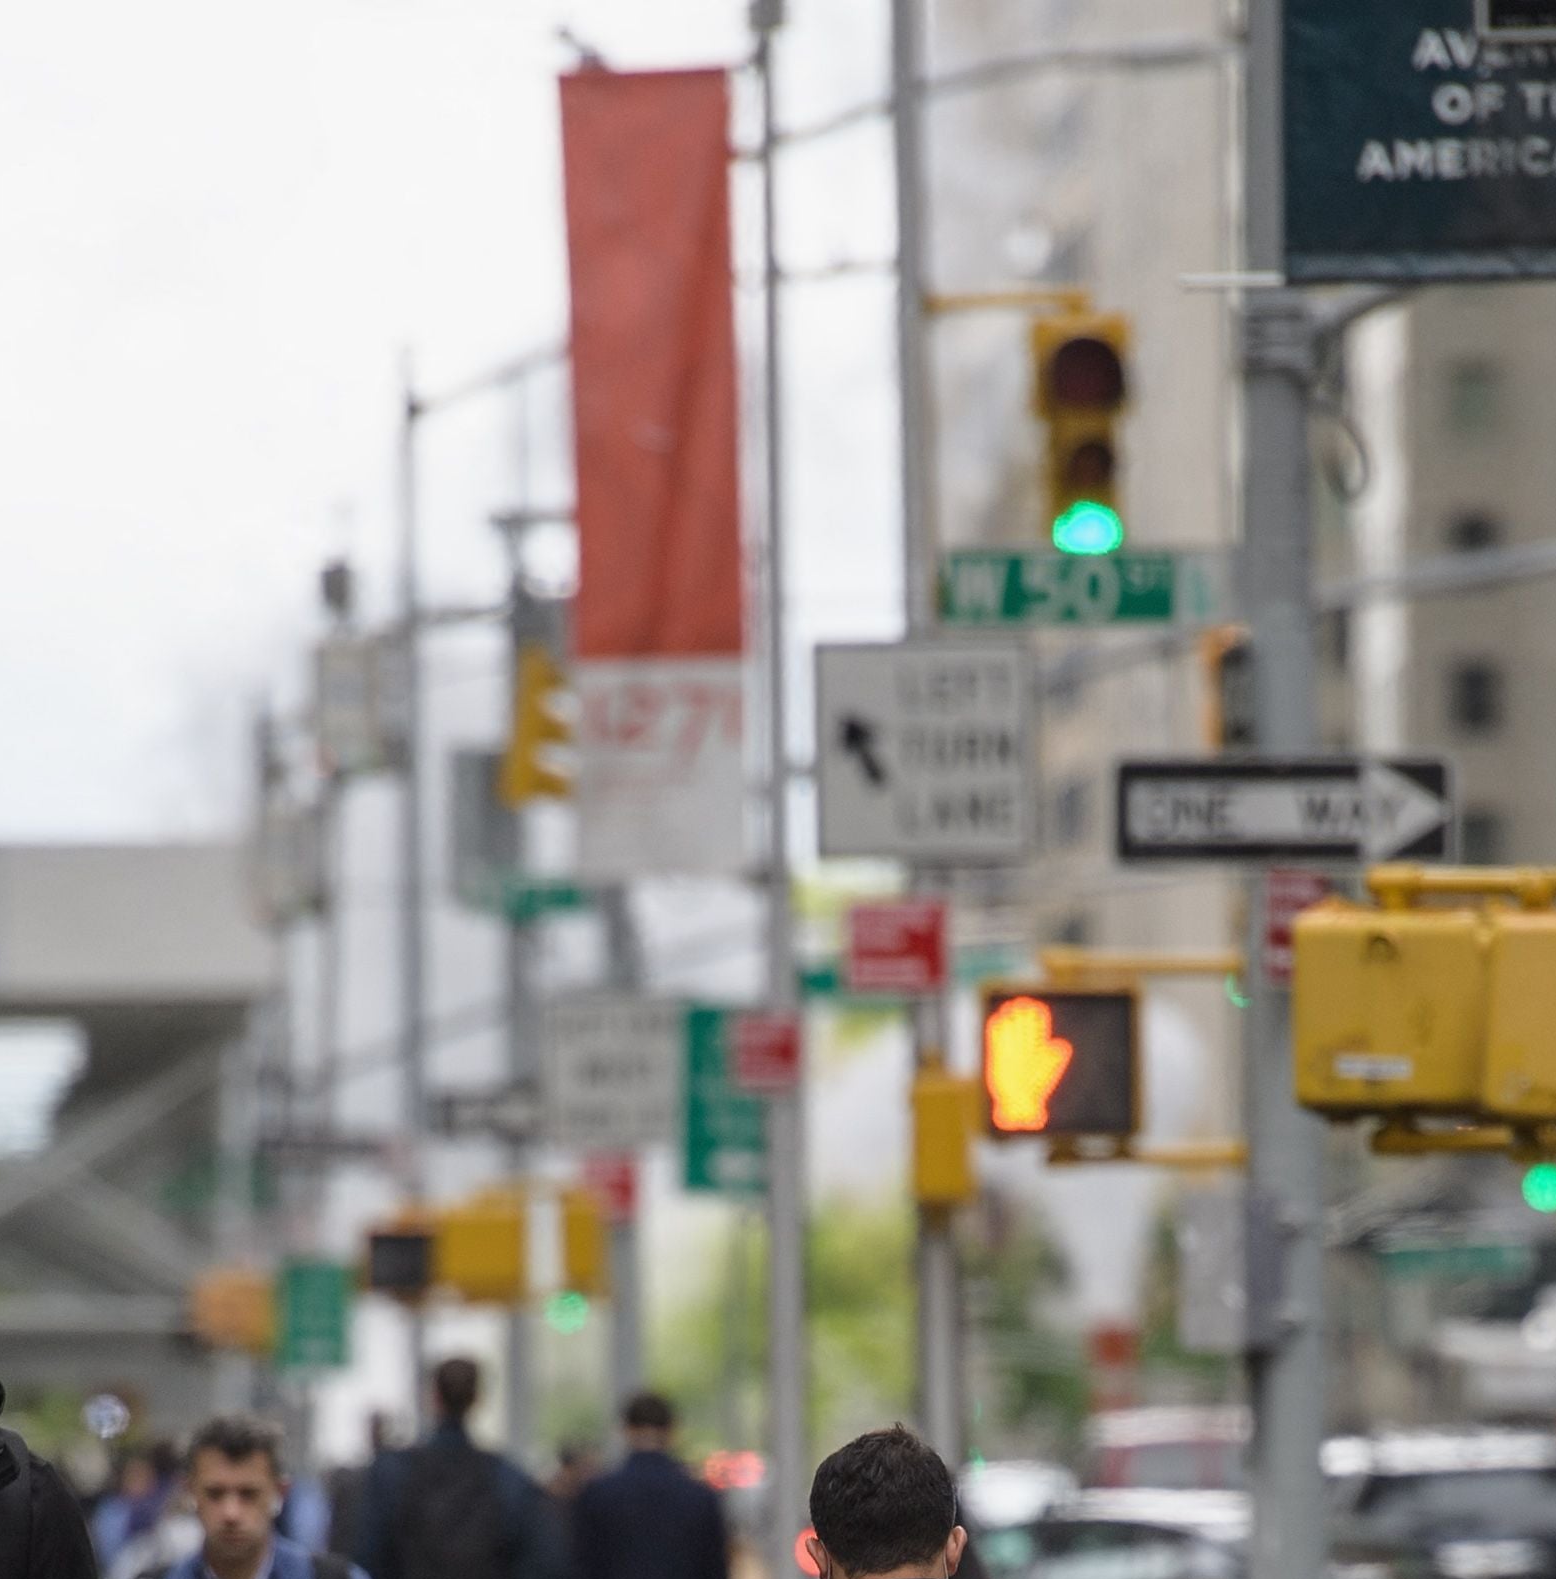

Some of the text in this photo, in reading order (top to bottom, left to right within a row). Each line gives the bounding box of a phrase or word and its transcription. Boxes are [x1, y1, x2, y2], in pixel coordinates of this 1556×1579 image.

[1432, 82, 1506, 125] OF
[955, 558, 1010, 619] W
[1020, 557, 1121, 624] 50
[896, 661, 1011, 710] LEFT
[899, 724, 1013, 769] TURN
[896, 790, 1013, 836] LANE
[1140, 783, 1410, 840] ONE WAY
